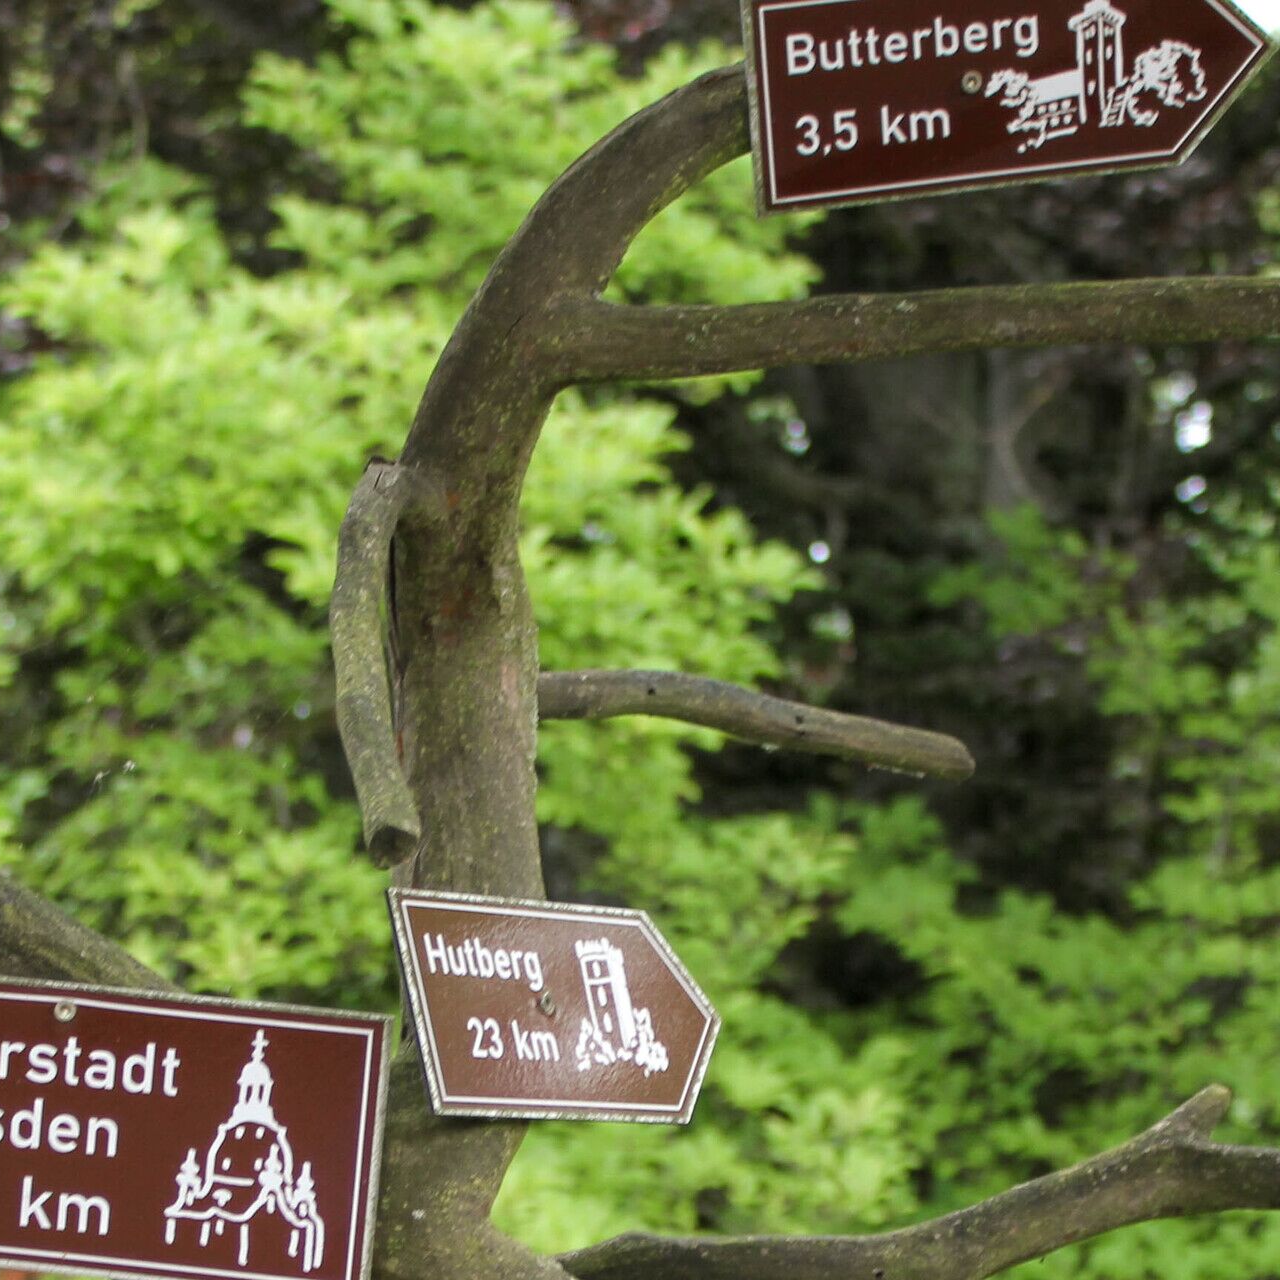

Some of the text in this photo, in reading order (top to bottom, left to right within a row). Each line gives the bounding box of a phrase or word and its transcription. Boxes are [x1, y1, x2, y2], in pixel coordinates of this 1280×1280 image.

[785, 15, 1039, 77] Butterberg
[795, 105, 951, 156] 3,5 km
[422, 932, 544, 992] Hutberg
[466, 1016, 561, 1063] 23 km
[19, 1175, 110, 1236] km
